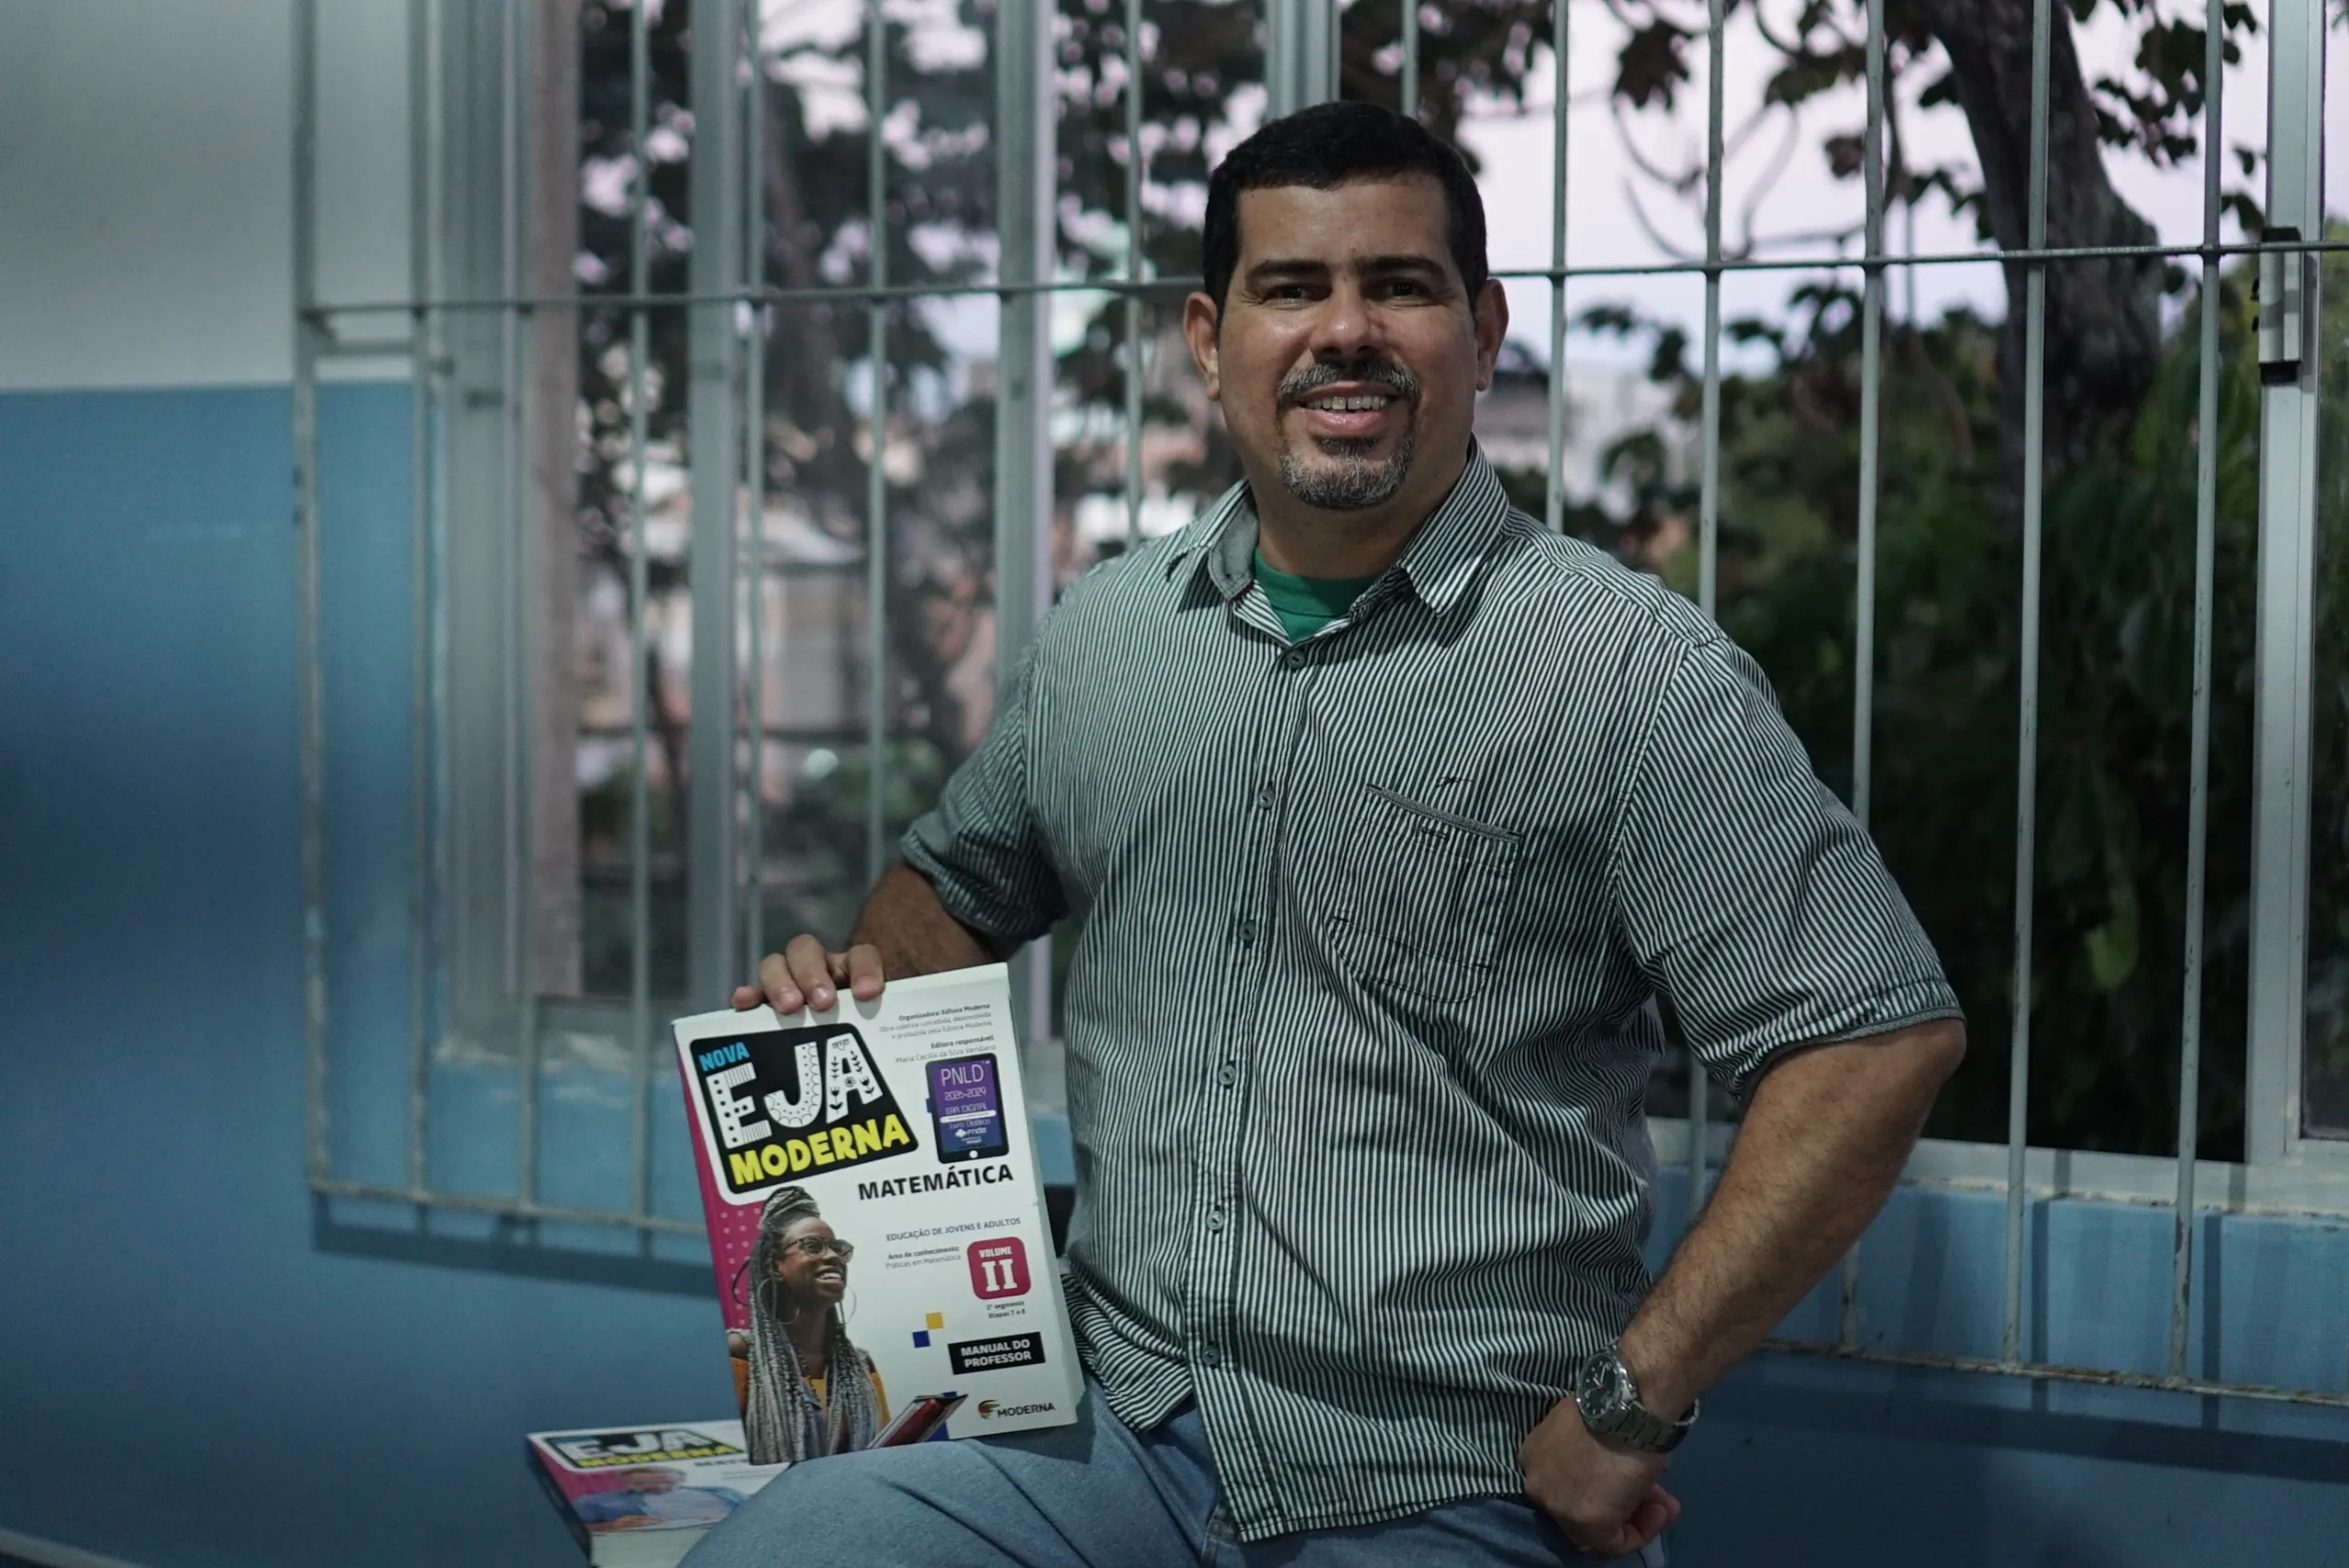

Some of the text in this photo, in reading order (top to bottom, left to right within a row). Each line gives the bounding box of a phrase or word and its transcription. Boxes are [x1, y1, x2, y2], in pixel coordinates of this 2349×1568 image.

[941, 1007, 963, 1016] Editora
[964, 1004, 990, 1012] Moderna
[930, 1034, 995, 1049] Editora responsável
[698, 1041, 751, 1072] NOVA
[941, 1064, 984, 1086] PNLD
[706, 1032, 883, 1150] EJA
[729, 1114, 910, 1185] MODERNA
[858, 1164, 1014, 1201] MATEMÁTICA
[886, 1229, 930, 1241] EDUCAÇÃO
[945, 1223, 975, 1234] JOVENS
[984, 1218, 1021, 1229] ADULTOS
[979, 1246, 1012, 1258] VOLUME
[982, 1259, 1018, 1292] II
[961, 1339, 1030, 1356] MANUAL DO
[964, 1351, 1031, 1368] PROFESSOR
[997, 1402, 1056, 1418] MODERNA
[557, 1431, 712, 1460] EJA
